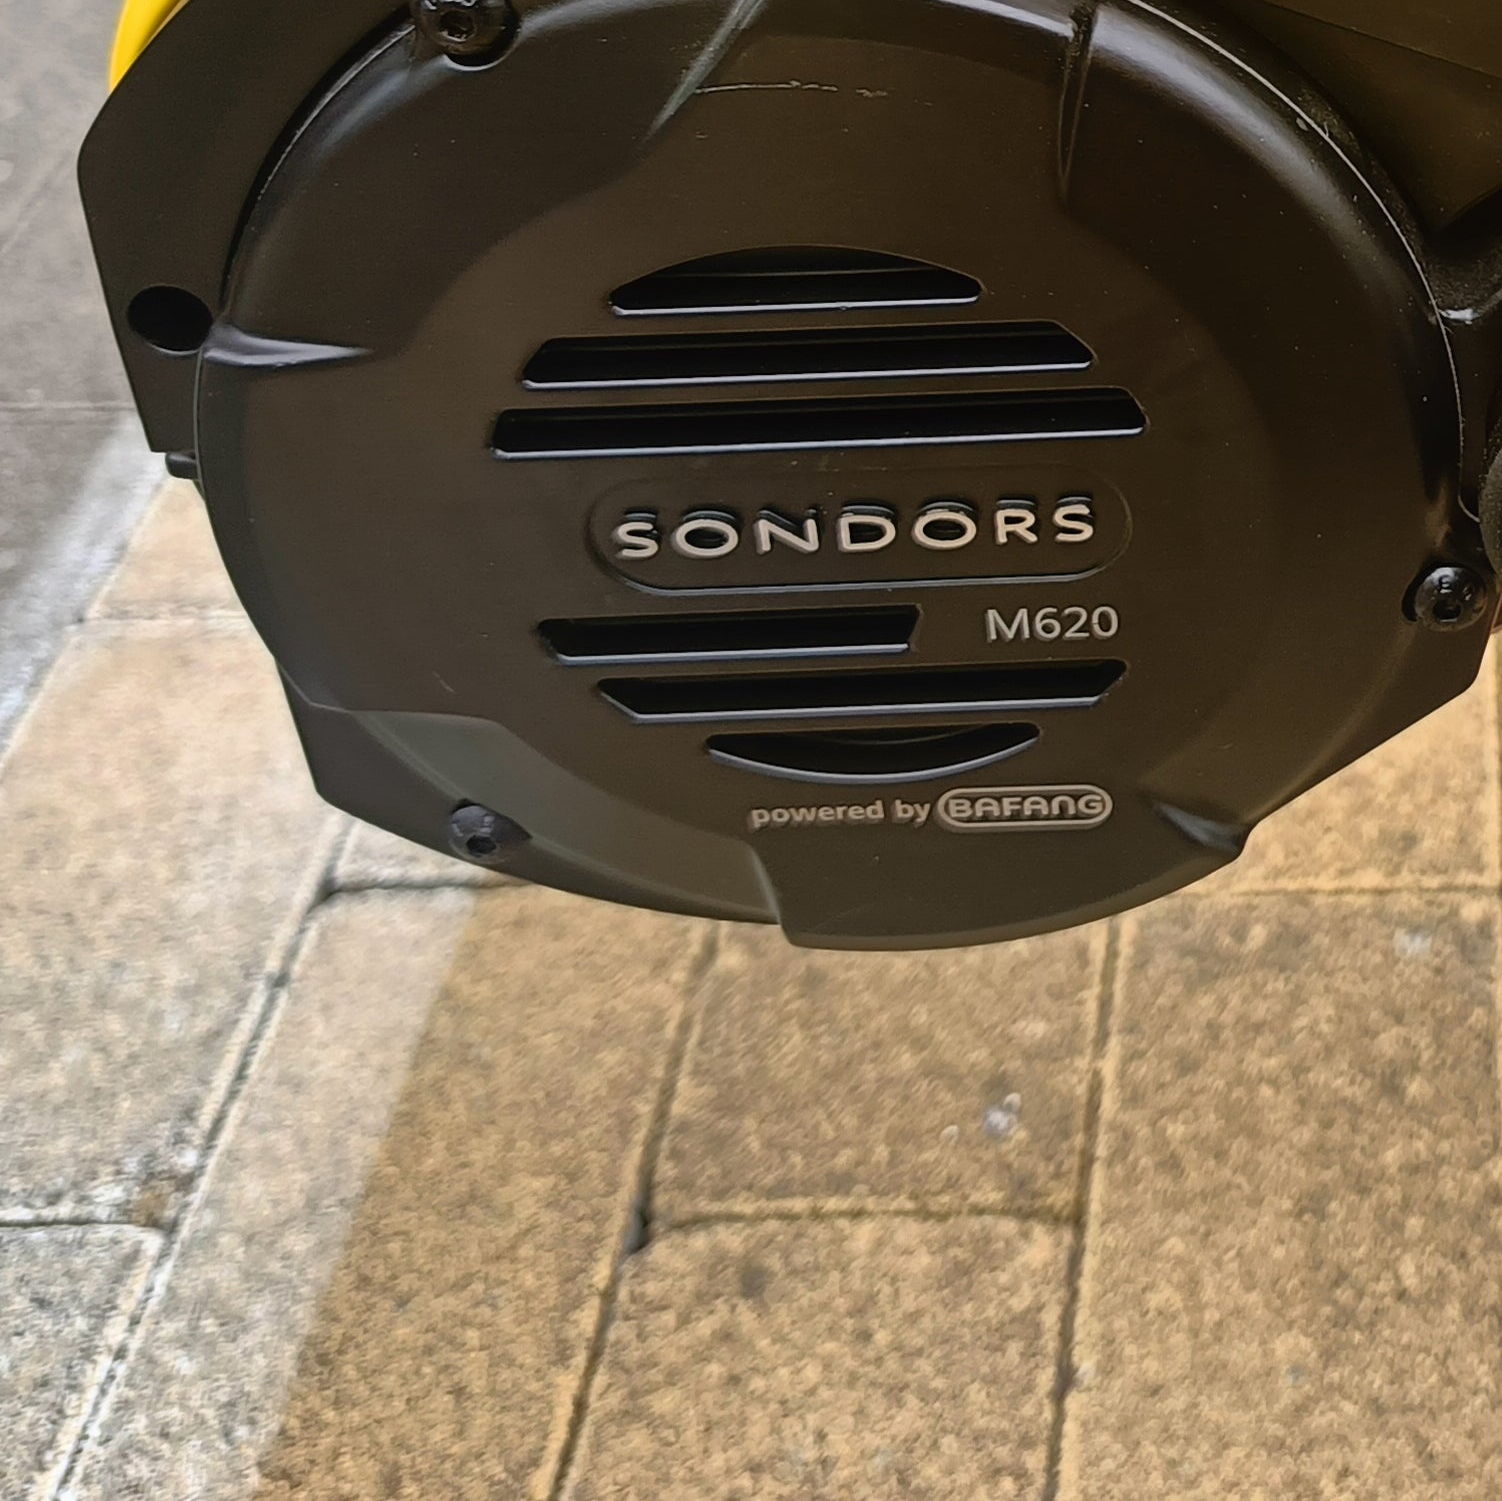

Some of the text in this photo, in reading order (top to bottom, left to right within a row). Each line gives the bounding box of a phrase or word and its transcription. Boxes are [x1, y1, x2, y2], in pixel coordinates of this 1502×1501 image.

[612, 501, 1096, 560] SONDORS
[985, 605, 1120, 644] M620
[749, 792, 1106, 832] powered by BAFANG
